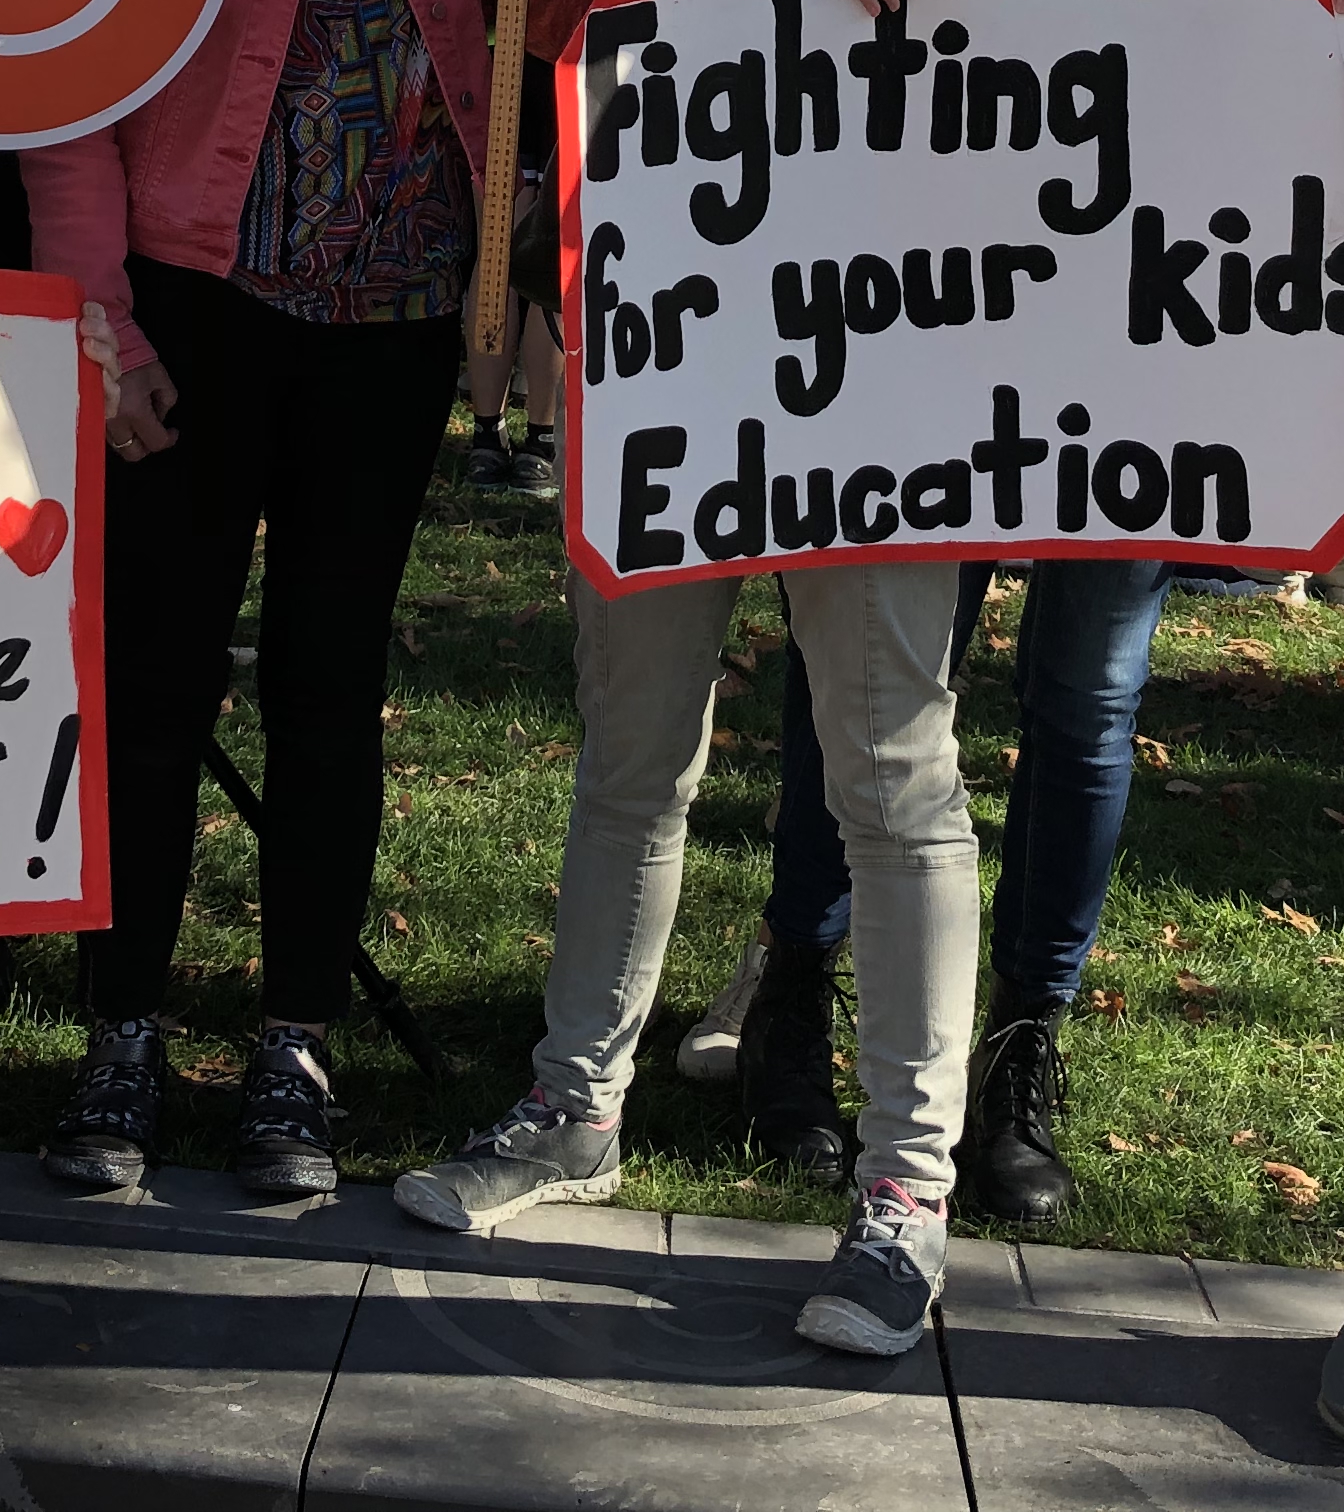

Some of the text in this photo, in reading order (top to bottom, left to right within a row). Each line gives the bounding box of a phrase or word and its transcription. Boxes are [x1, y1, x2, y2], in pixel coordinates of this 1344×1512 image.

[584, 221, 719, 386] for
[771, 243, 1057, 417] your
[615, 384, 1253, 574] Education
